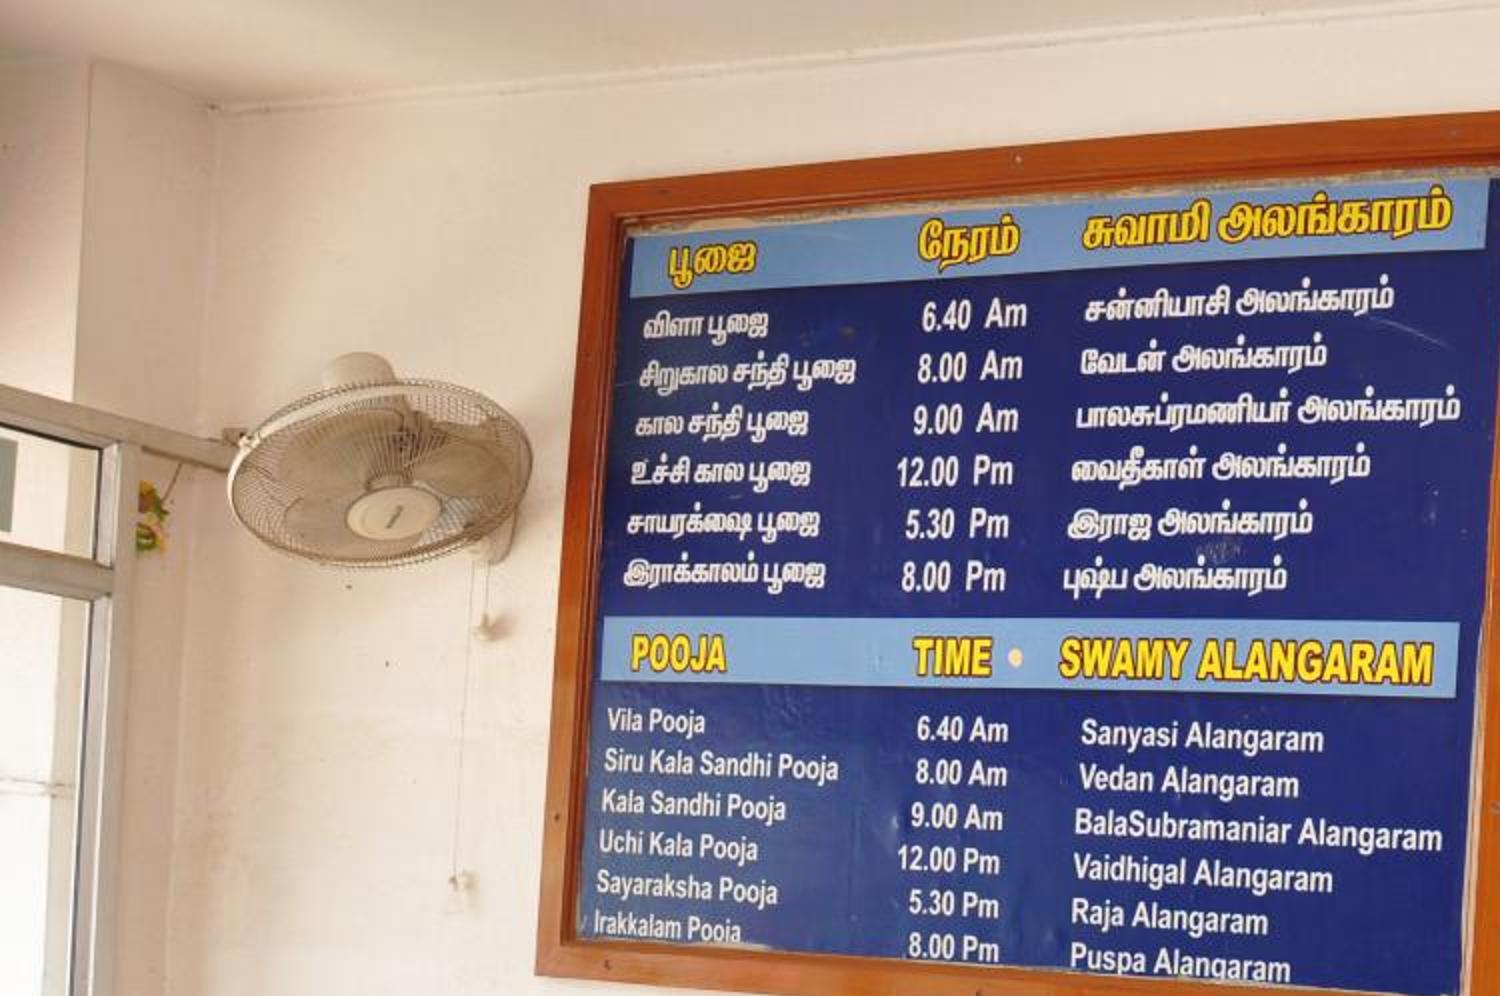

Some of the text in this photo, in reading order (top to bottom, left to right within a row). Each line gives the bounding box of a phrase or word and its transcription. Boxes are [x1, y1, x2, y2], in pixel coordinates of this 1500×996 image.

[1082, 186, 1453, 249] சுவாமி அலங்காரம்
[918, 215, 1021, 269] நேரம்
[667, 241, 757, 288] பூஜை
[922, 297, 1027, 333] 6.40 Am
[1084, 273, 1395, 322] சன்னியாசி அலங்காரம்
[707, 312, 769, 346] பூஜை
[917, 349, 1023, 384] 8.00 Am
[1080, 331, 1328, 375] வேடன் அலங்காரம்
[639, 350, 857, 397] சிறுகால சந்தி பூஜை
[635, 401, 809, 443] கால சந்தி பூஜை
[913, 401, 1019, 435] 9.00 Am
[1297, 384, 1461, 428] அலங்காரம்
[631, 452, 812, 493] உச்சி கால பூஜை
[897, 454, 1013, 488] 12.00 Pm
[1211, 441, 1371, 485] அலங்காரம்
[757, 511, 821, 544] பூஜை
[905, 507, 1009, 540] 5.30 Pm
[1067, 498, 1314, 543] இராஜ அலங்காரம்
[623, 550, 827, 595] இராக்காலம் பூஜை
[901, 560, 1006, 593] 8.00 Pm
[1063, 554, 1287, 600] புஷ்ப அலங்காரம்
[631, 633, 727, 672] POOJA
[913, 636, 992, 676] TIME
[1059, 637, 1434, 685] SWAMY ALANGARAM
[607, 707, 706, 740] Vila Pooja
[917, 715, 1009, 743] 6.40 Am
[1081, 718, 1324, 757] Sanyasi Alangaram
[603, 747, 839, 787] Siru Kala Sandhi Pooja
[915, 758, 1008, 787] 8.00 Am
[1079, 762, 1299, 803] Vedan Alangaram
[601, 787, 787, 827] Kala Sandhi Pooja
[911, 801, 1003, 831] 9.00 Am
[599, 827, 759, 867] Uchi Kala Pooja
[1075, 807, 1443, 856] BalaSubramaniar Alangaram
[897, 844, 1000, 875] 12.00 Pm
[1073, 852, 1333, 897] Vaidhigal Alangaram
[595, 868, 778, 910] Sayaraksha Pooja
[909, 888, 999, 919] 5.30 Pm
[593, 908, 683, 942] Irakkalam
[1071, 897, 1269, 939] Raja Alangaram
[908, 931, 999, 963] 8.00 Pm
[1070, 942, 1146, 975] Puspa
